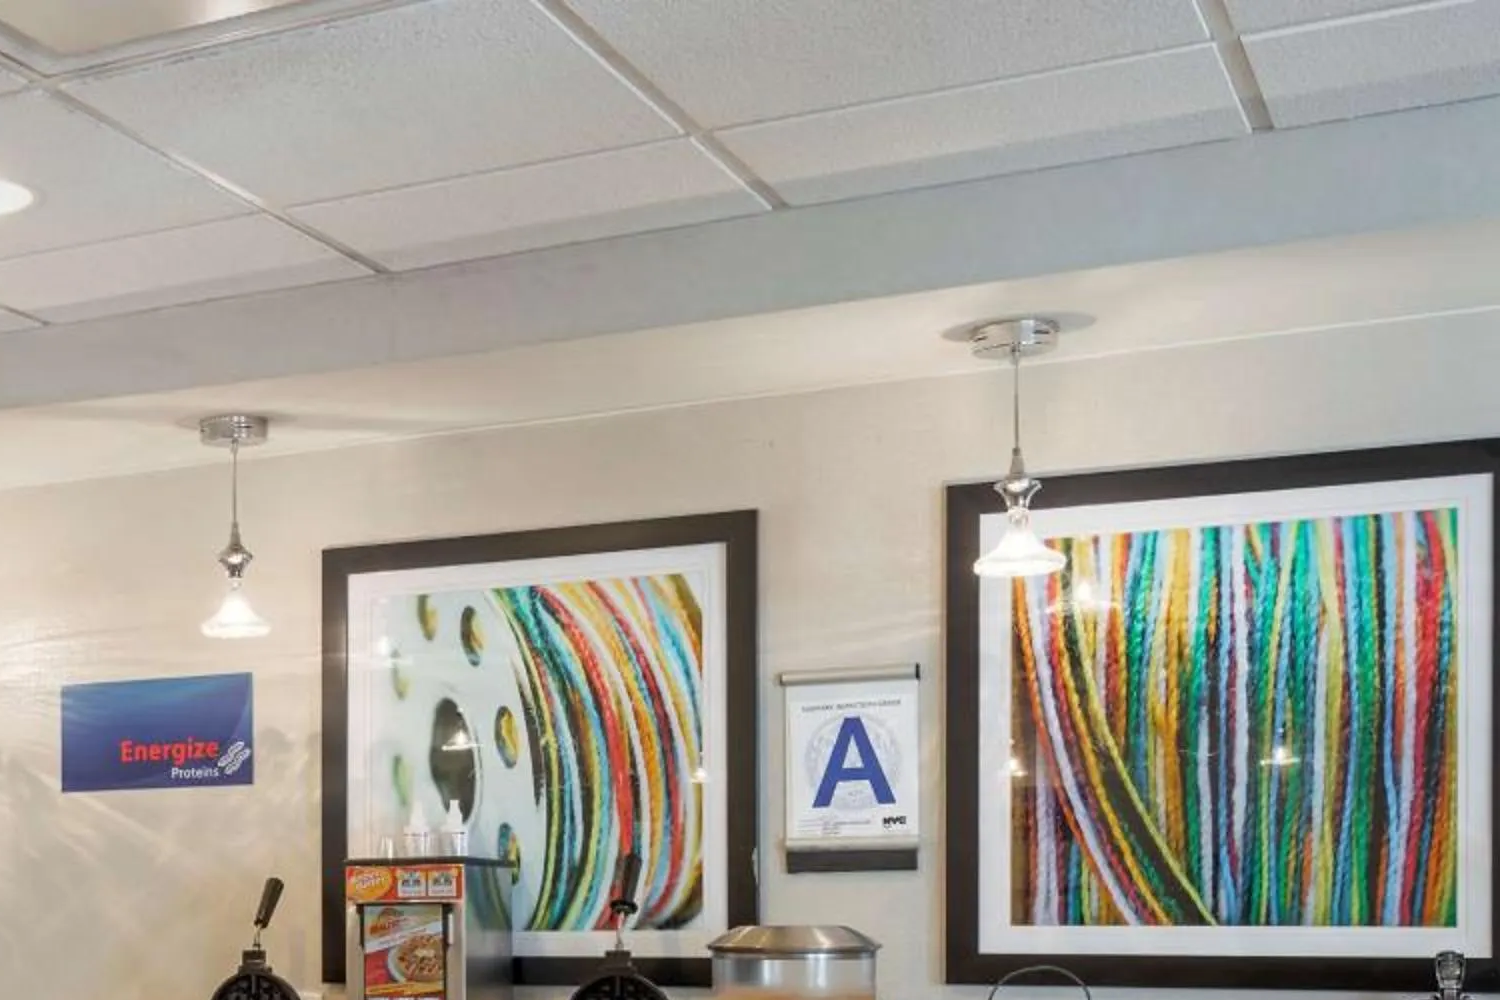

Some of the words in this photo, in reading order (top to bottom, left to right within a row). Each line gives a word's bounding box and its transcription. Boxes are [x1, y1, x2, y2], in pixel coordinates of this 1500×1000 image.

[119, 735, 220, 768] Energize
[812, 716, 897, 809] A
[171, 765, 220, 780] Proteins
